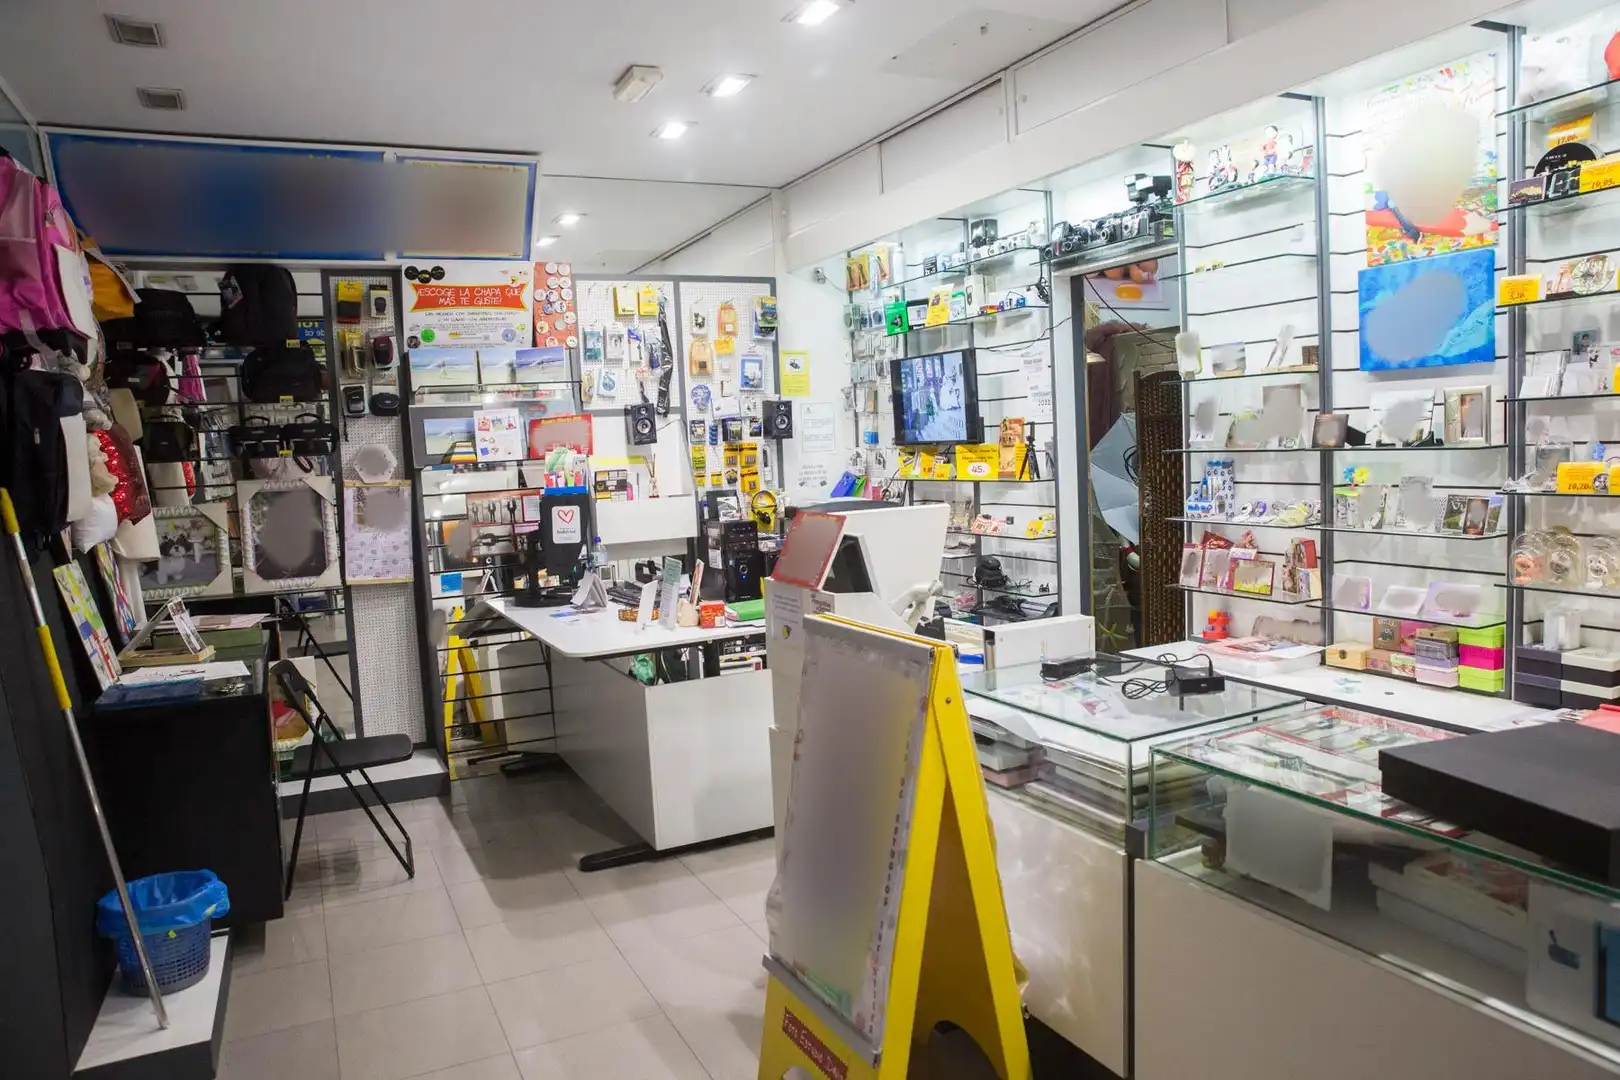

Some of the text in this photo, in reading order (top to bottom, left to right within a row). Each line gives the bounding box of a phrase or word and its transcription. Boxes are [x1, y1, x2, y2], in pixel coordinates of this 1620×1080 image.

[459, 288, 470, 298] LA
[473, 287, 502, 298] CHAPA
[505, 287, 522, 299] QUE
[460, 297, 470, 306] TE
